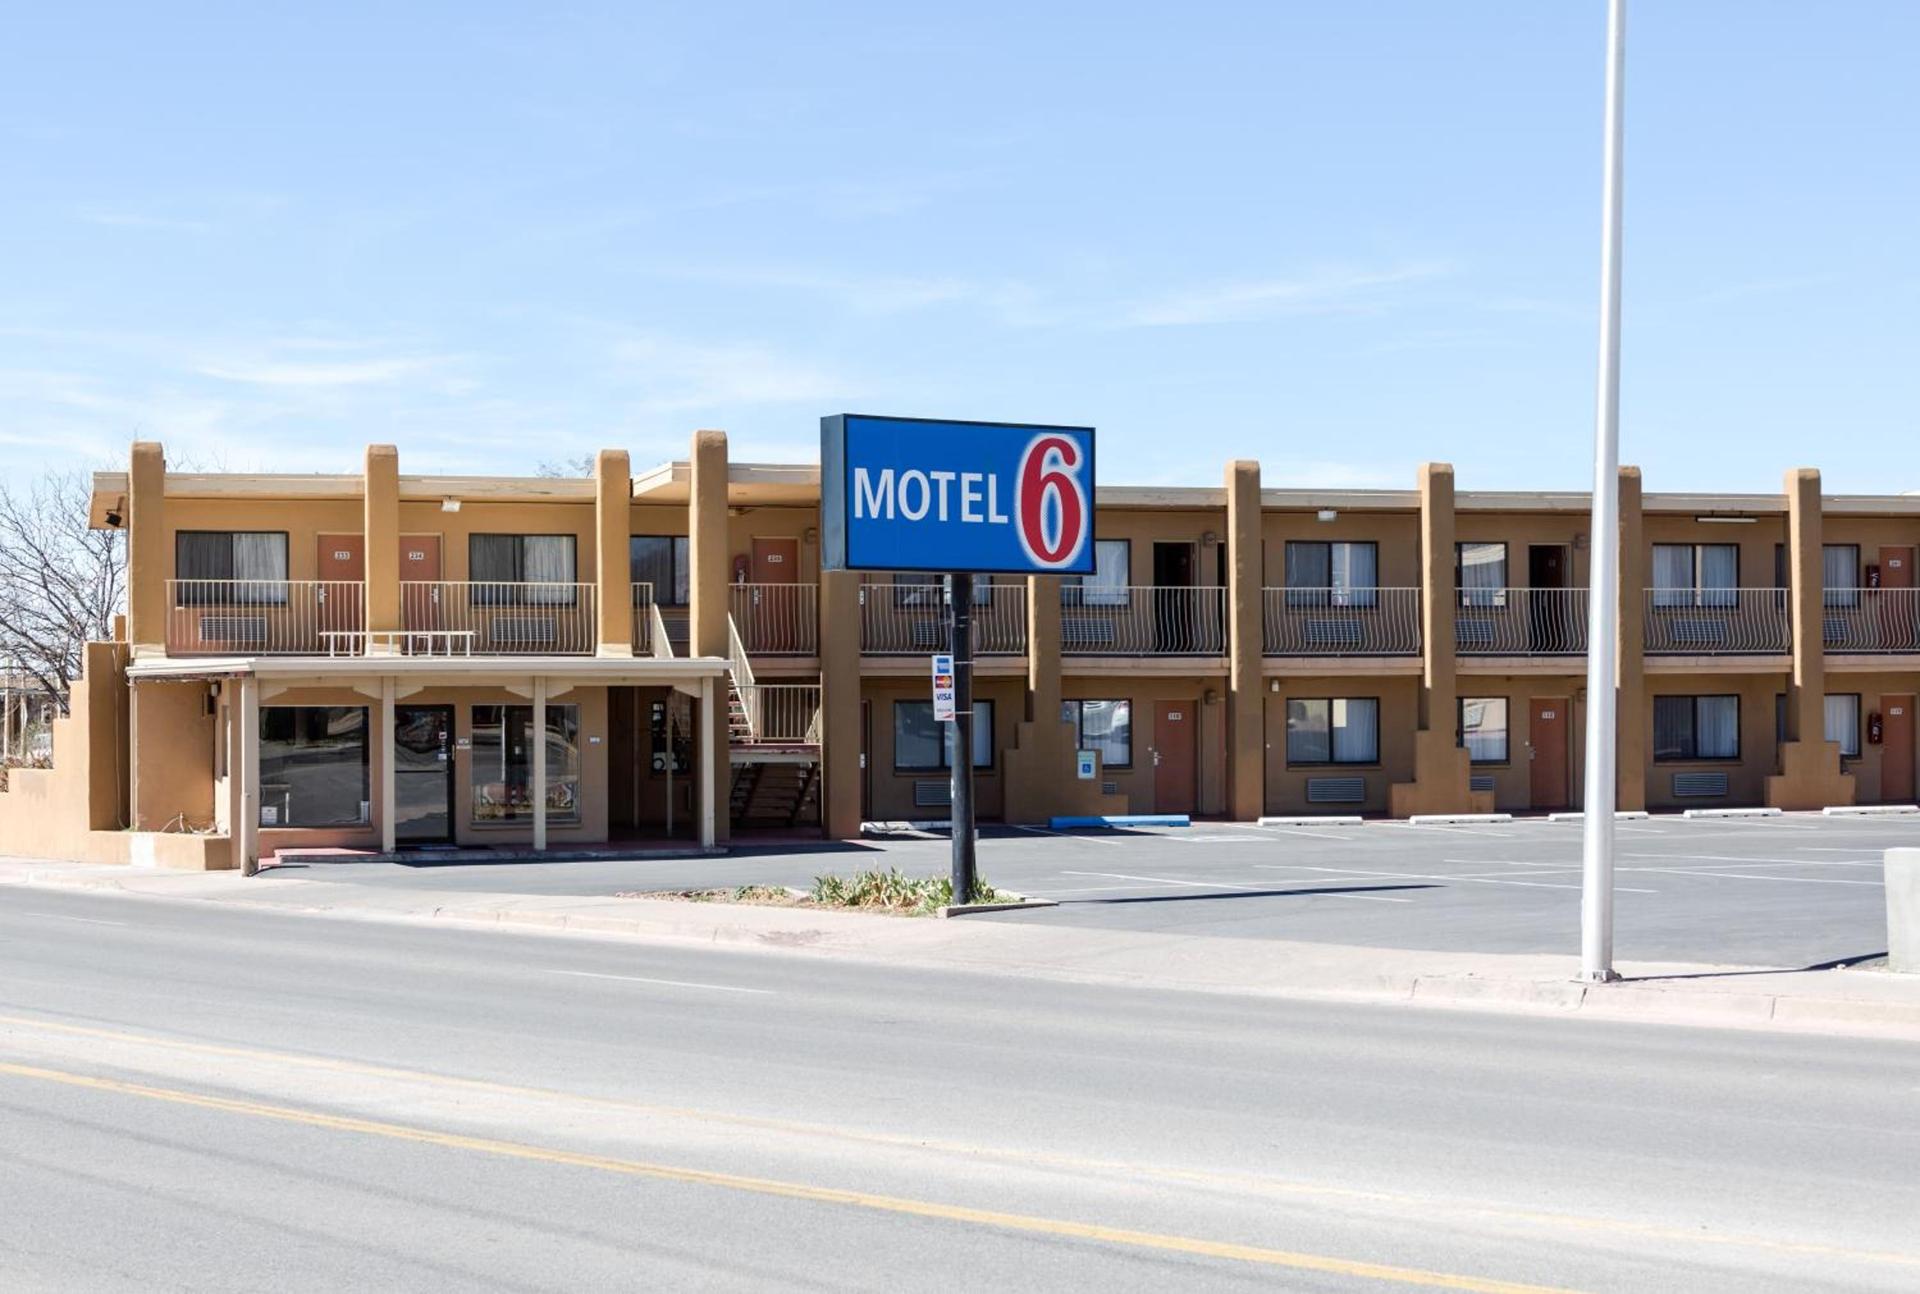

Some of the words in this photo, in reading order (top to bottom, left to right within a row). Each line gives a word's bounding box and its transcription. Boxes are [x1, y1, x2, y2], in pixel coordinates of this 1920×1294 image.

[854, 467, 1009, 524] MOTEL
[1017, 434, 1085, 566] 6
[936, 693, 952, 701] VISA
